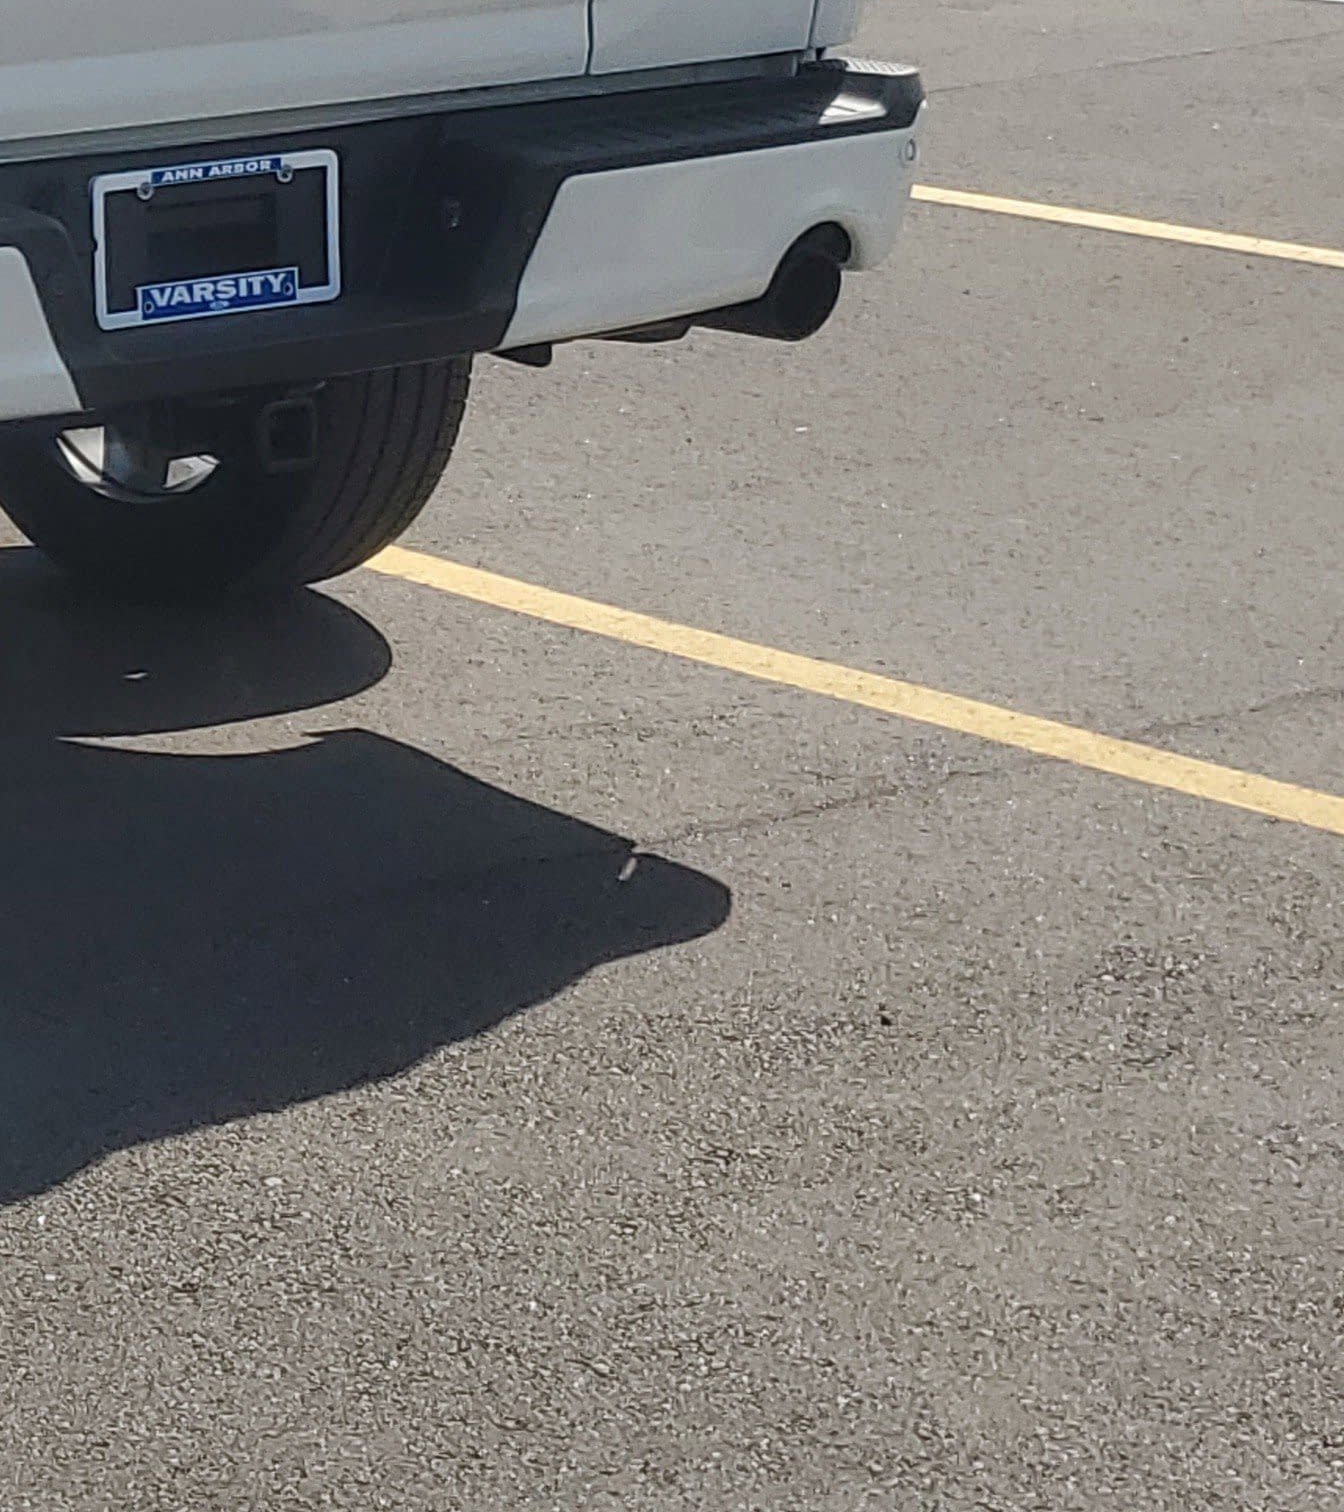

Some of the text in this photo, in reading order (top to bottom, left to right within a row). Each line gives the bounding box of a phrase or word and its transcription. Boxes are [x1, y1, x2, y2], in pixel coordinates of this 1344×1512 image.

[162, 159, 273, 184] ANN ARBOR
[149, 272, 289, 307] VARSITY
